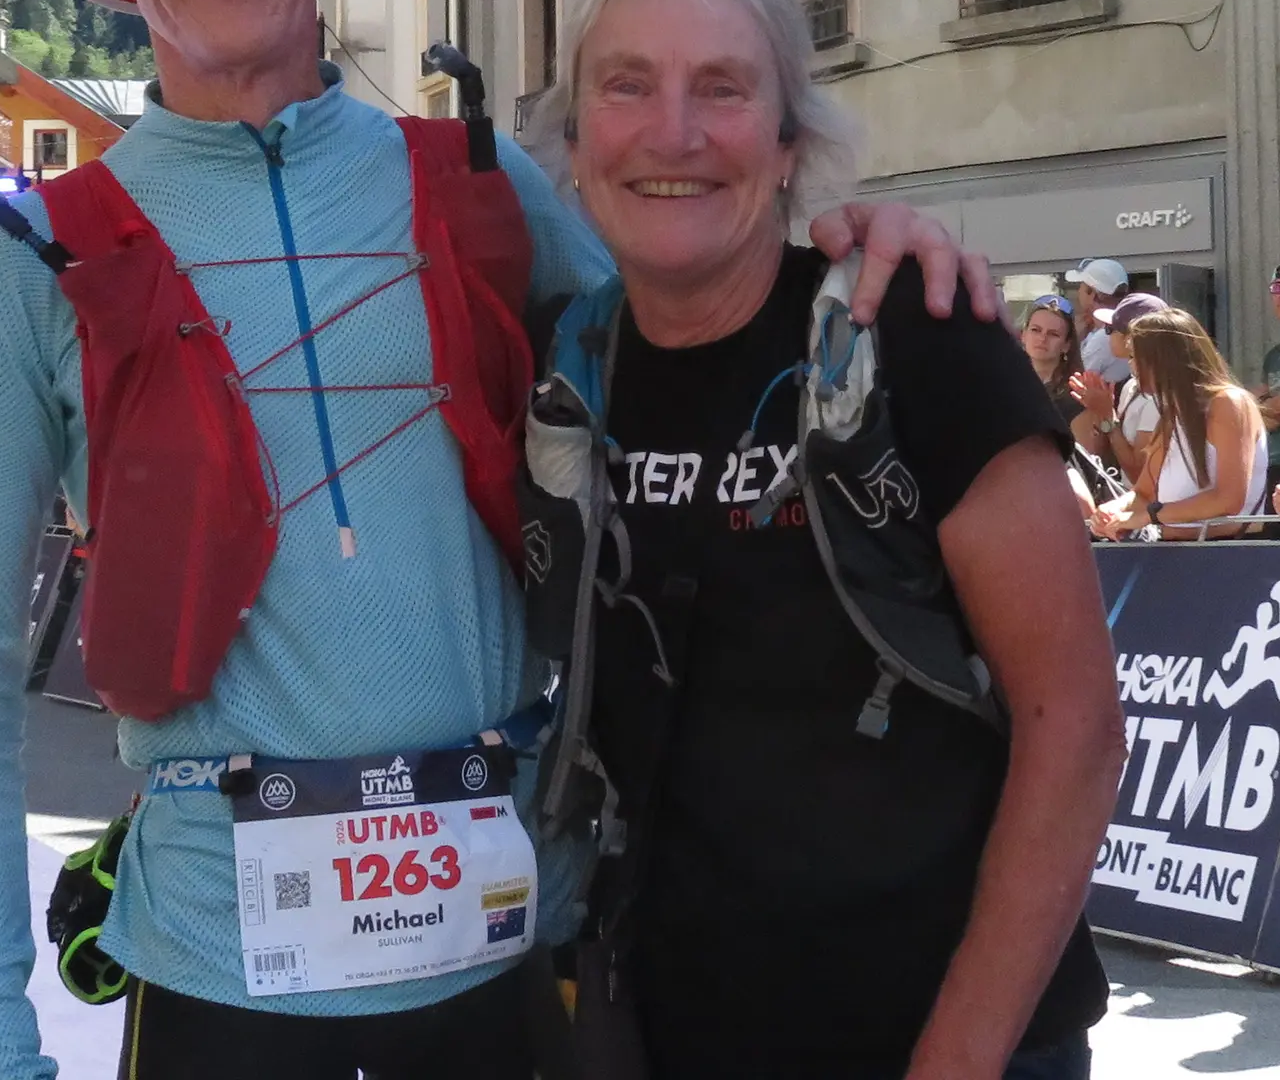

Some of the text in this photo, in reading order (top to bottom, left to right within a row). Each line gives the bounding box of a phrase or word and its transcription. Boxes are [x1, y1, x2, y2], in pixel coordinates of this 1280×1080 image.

[1116, 209, 1175, 229] CRAFT
[1116, 653, 1204, 707] HOKA
[153, 759, 227, 789] HOK
[361, 775, 414, 795] UTMB
[332, 845, 462, 902] 1263
[1096, 839, 1246, 906] ONT-BLANC
[352, 903, 444, 935] Michael
[378, 934, 423, 948] SULLIVAN
